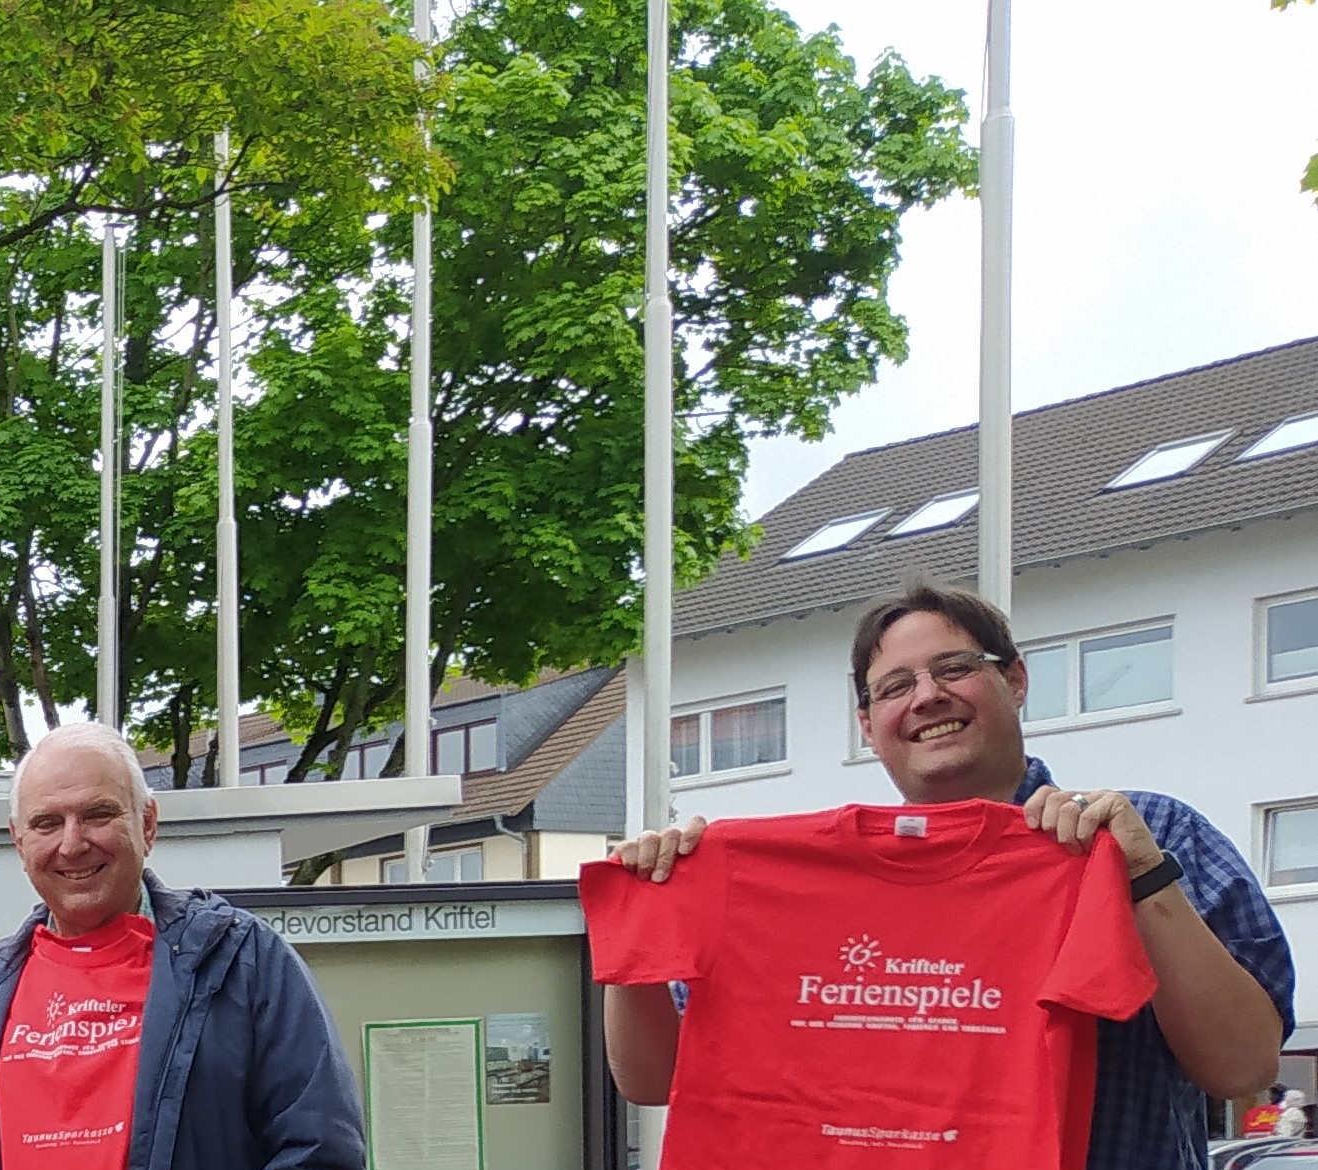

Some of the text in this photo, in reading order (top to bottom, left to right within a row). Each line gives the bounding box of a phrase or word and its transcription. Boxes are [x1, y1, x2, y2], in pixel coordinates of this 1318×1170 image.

[261, 905, 496, 934] devorstand Kriftel
[885, 958, 965, 975] Krifteler
[68, 999, 126, 1015] Krifteler
[797, 975, 1001, 1014] Ferienspiele
[8, 1015, 142, 1045] Ferienspiel
